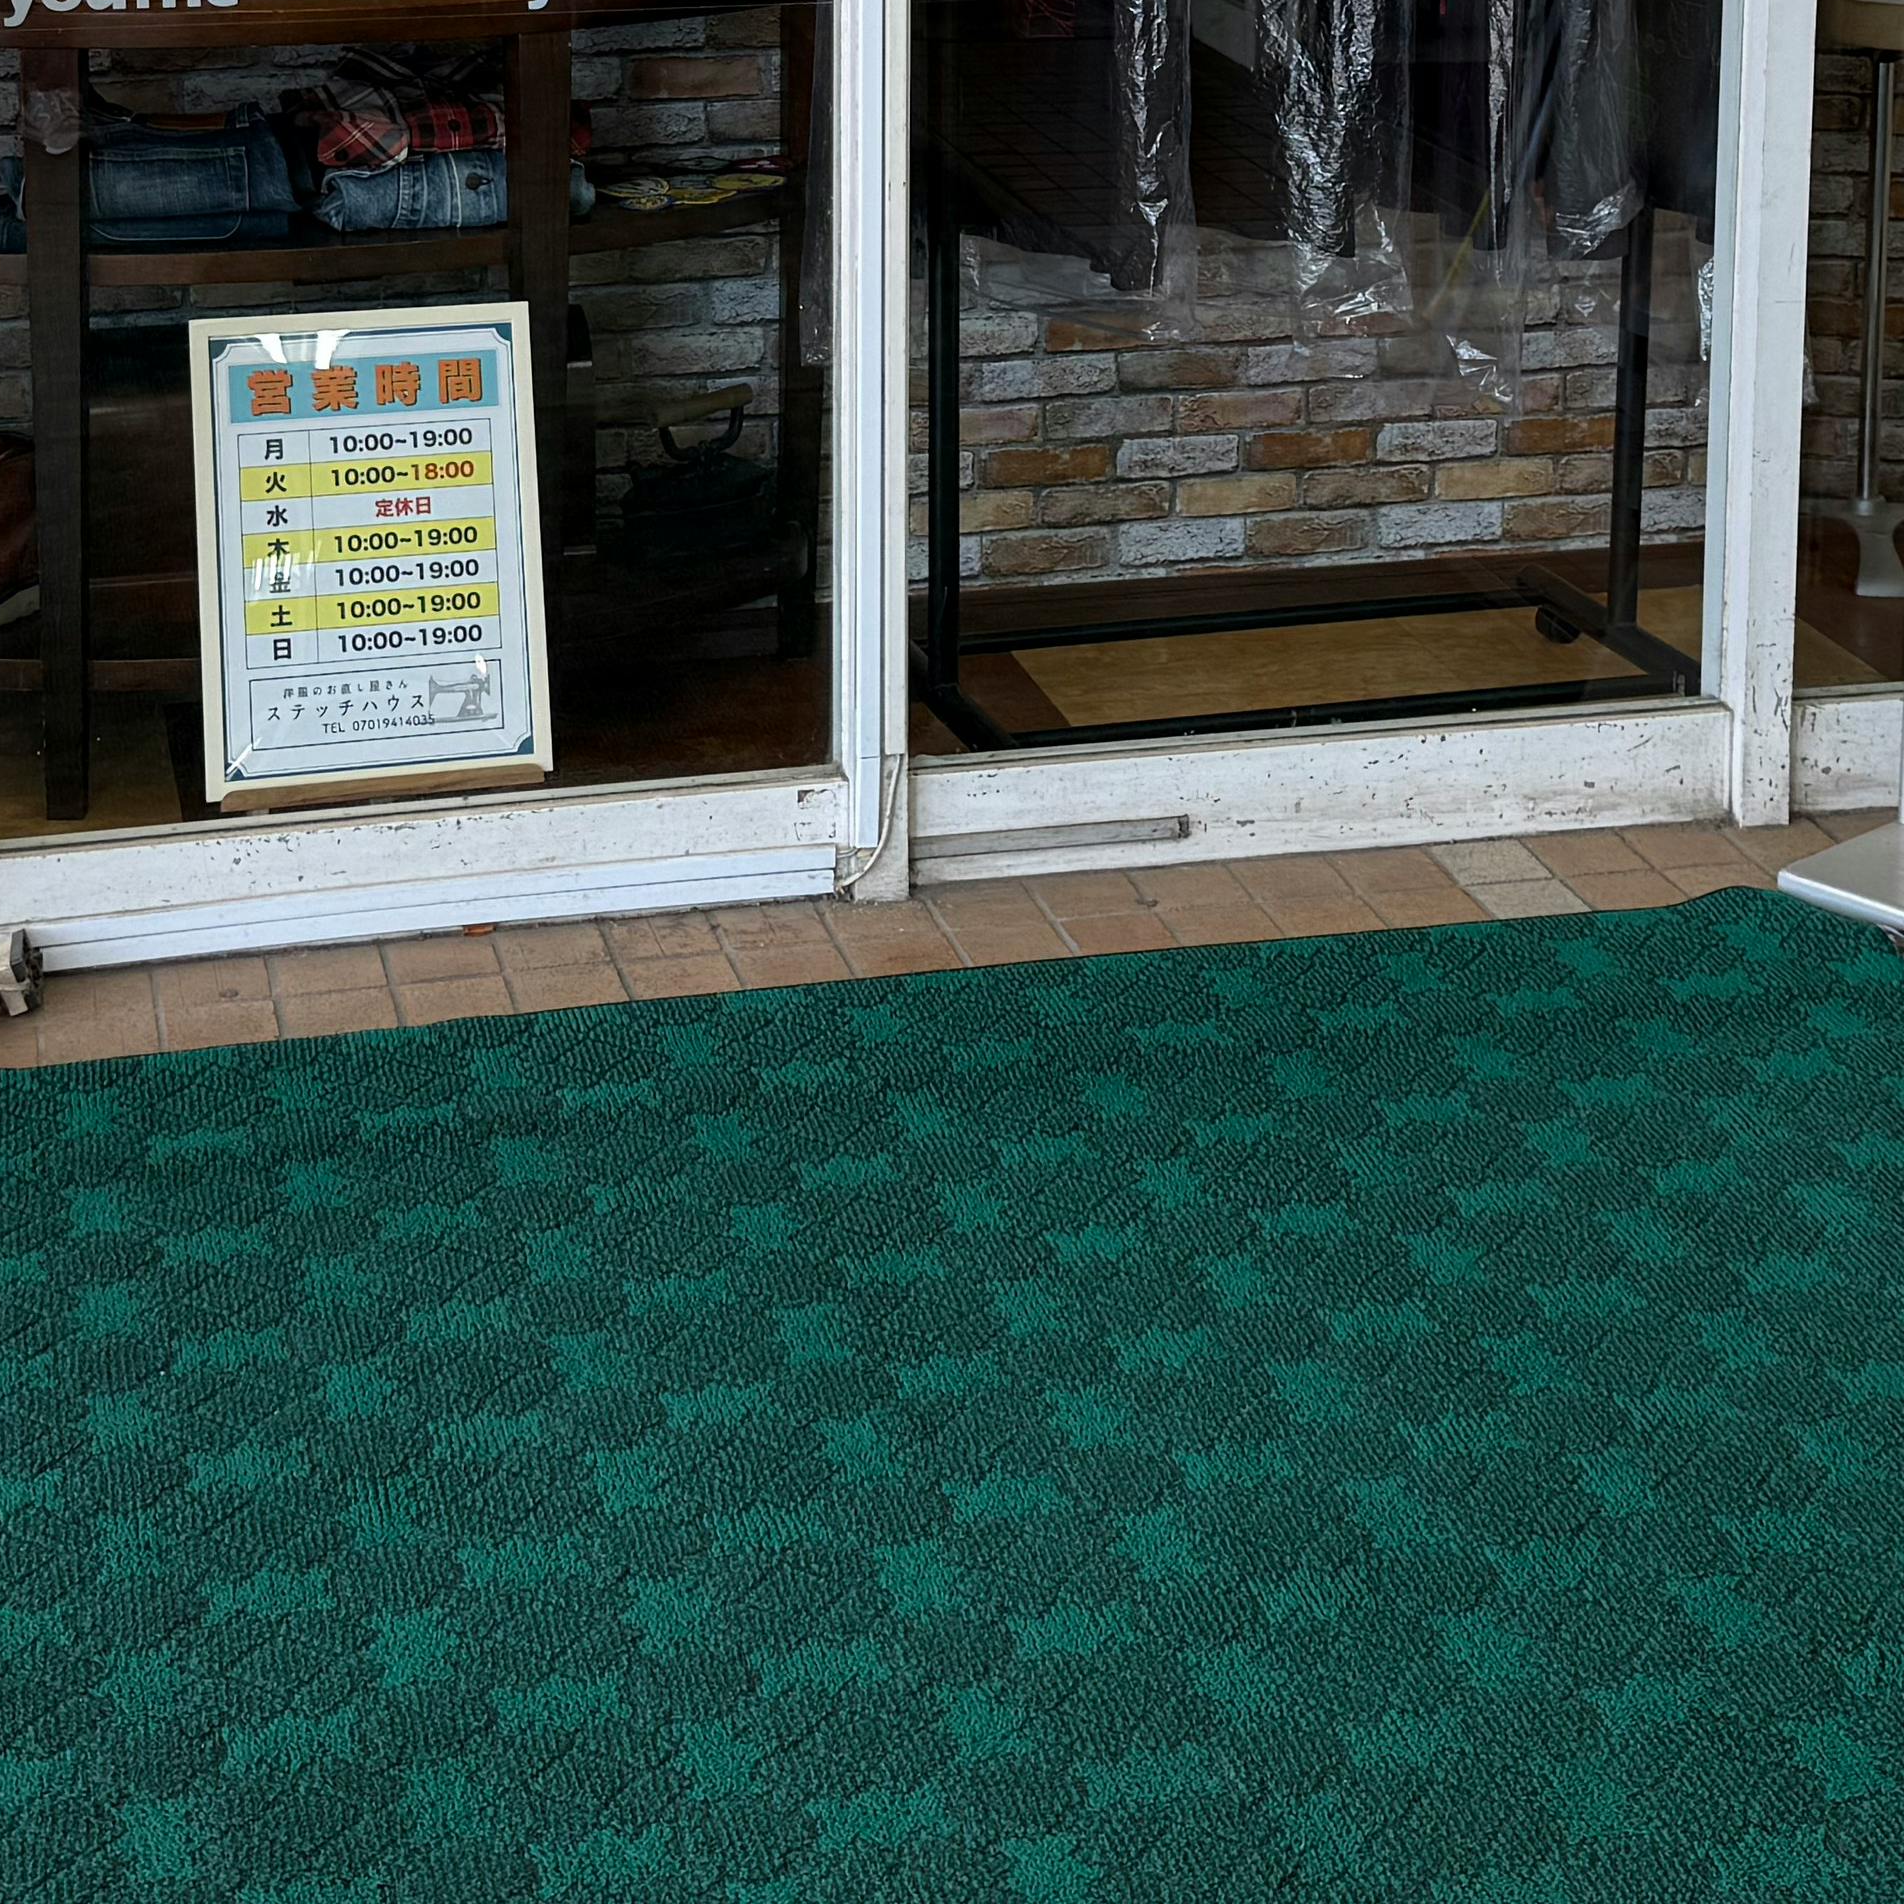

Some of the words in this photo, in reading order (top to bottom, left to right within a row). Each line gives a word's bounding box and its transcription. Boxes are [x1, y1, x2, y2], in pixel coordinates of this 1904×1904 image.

[247, 358, 483, 416] 営業時間
[264, 438, 285, 460] 月
[265, 472, 286, 494] 火
[266, 506, 288, 526] 水
[375, 496, 432, 517] 定休日
[267, 538, 290, 558] 木
[270, 606, 293, 627] 土
[273, 639, 292, 660] 日
[267, 692, 425, 722] ステッチハウス
[323, 720, 345, 736] TEL
[353, 713, 435, 733] 07019414035
